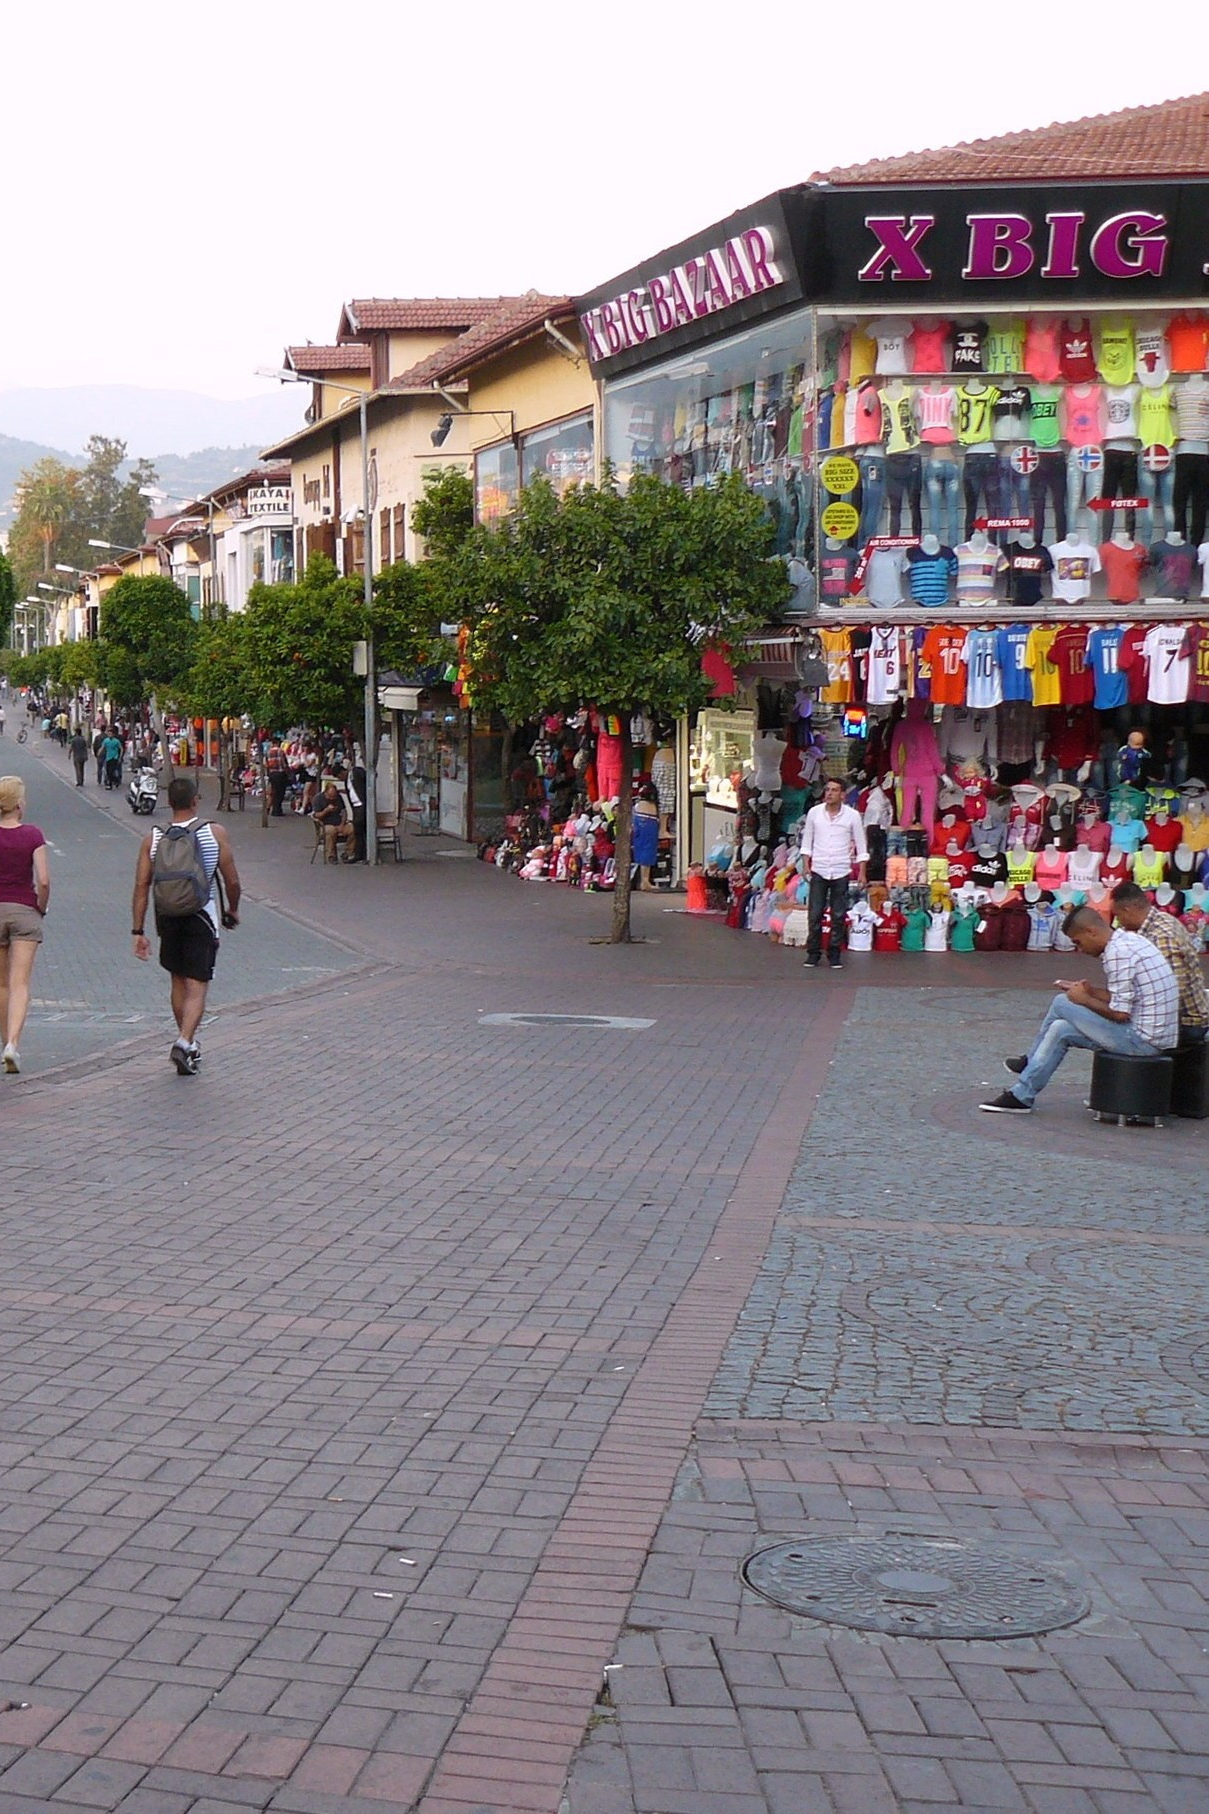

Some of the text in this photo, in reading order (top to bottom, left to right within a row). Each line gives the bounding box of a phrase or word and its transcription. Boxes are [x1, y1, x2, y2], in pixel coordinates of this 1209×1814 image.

[857, 211, 1168, 281] X BIG
[581, 226, 783, 362] X BIG BAZAAR
[883, 343, 901, 351] BOY
[955, 349, 981, 364] FAKE
[960, 399, 988, 433] 87
[253, 489, 283, 499] KAYA
[250, 503, 289, 512] TEXTILE
[987, 519, 1011, 527] REMA
[1014, 557, 1041, 568] OBEY
[939, 648, 961, 674] 10
[1015, 644, 1026, 670] 9
[1070, 649, 1085, 675] 10
[1102, 647, 1118, 674] 11
[1166, 649, 1178, 673] 7
[828, 661, 850, 681] 24
[886, 661, 894, 675] 6
[971, 863, 997, 876] adidas
